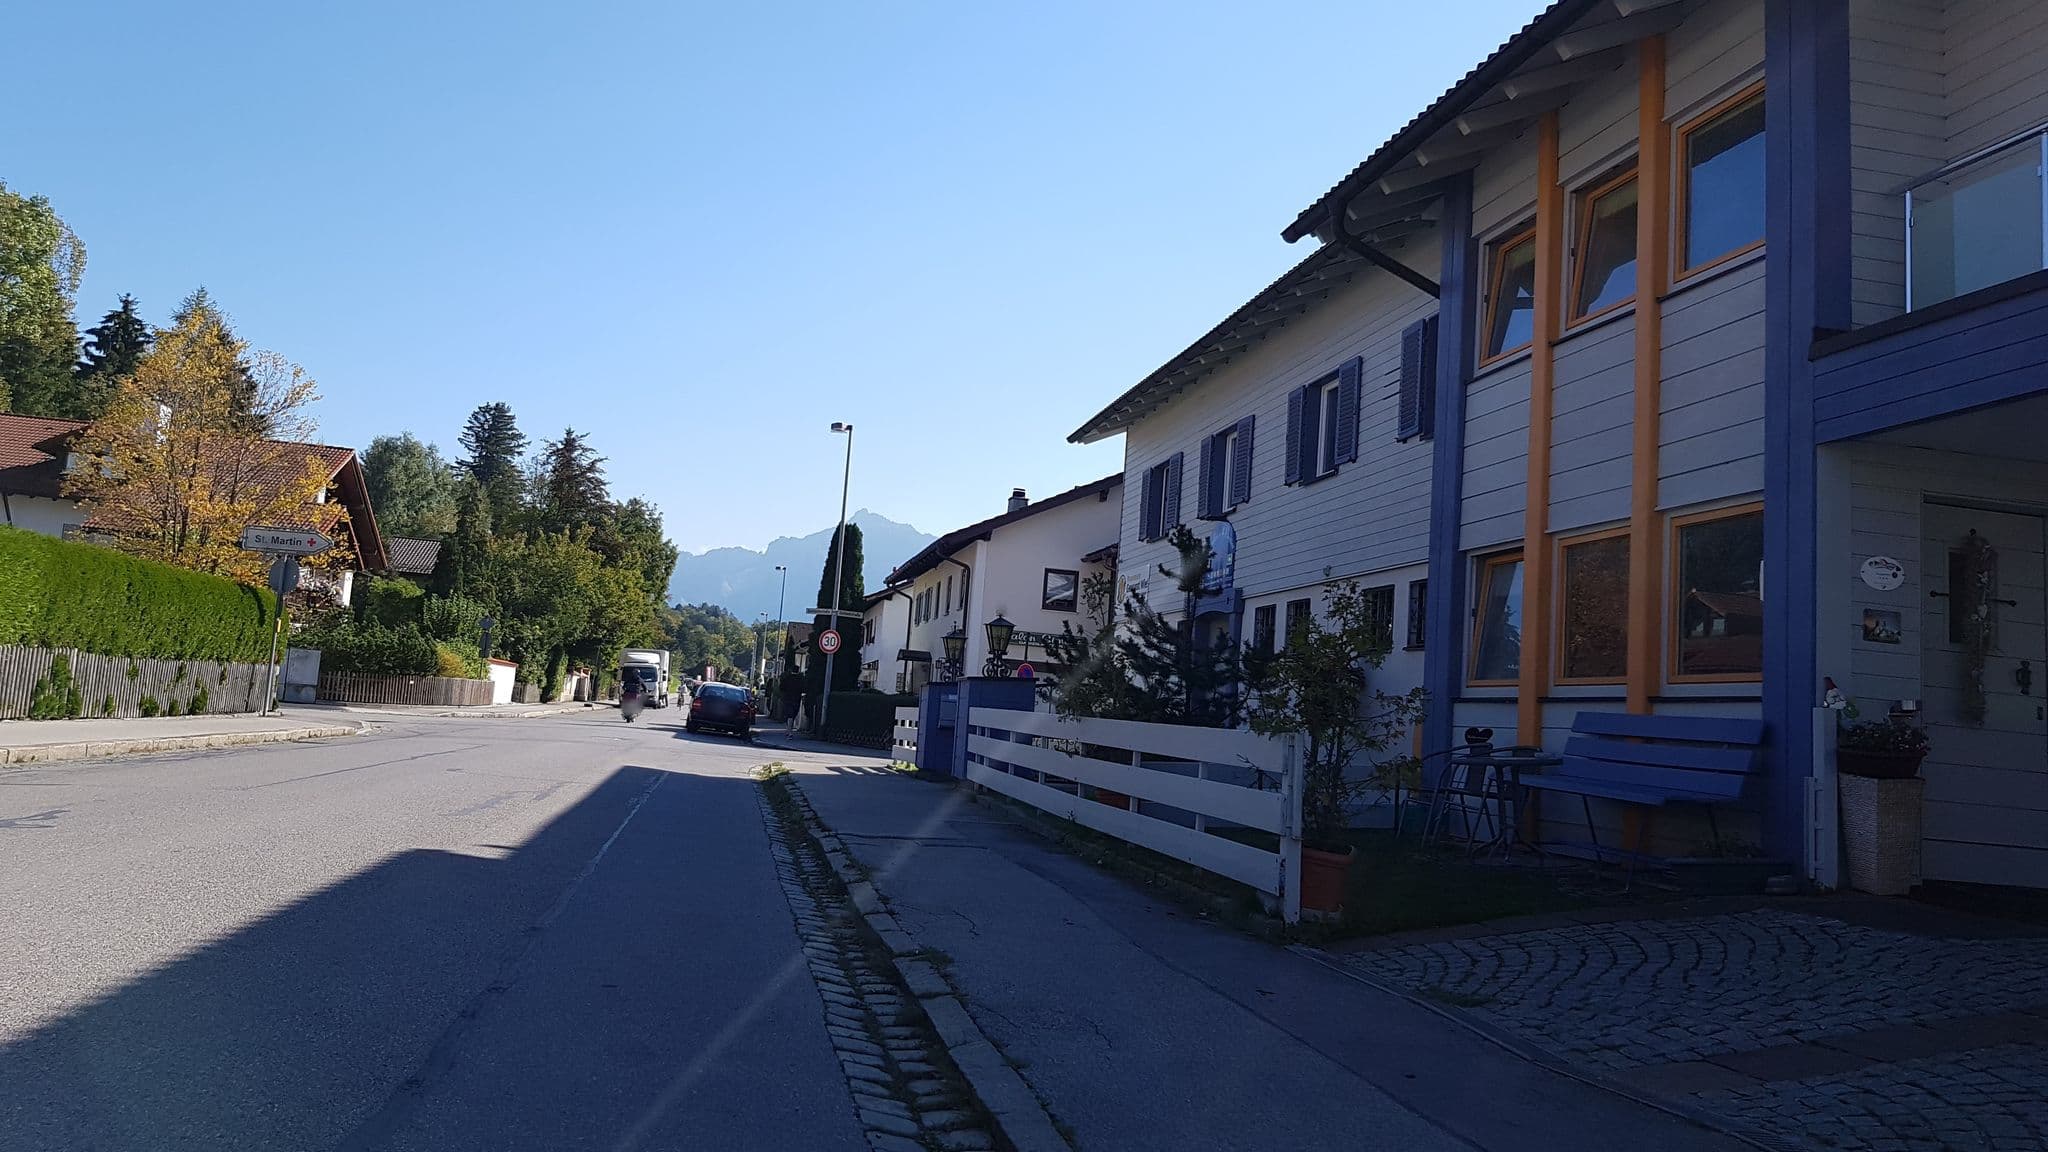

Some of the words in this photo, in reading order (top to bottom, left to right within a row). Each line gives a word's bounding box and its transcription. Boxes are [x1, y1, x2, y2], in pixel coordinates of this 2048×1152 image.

[254, 535, 267, 544] St.
[271, 535, 302, 546] Martin
[824, 637, 836, 647] 30
